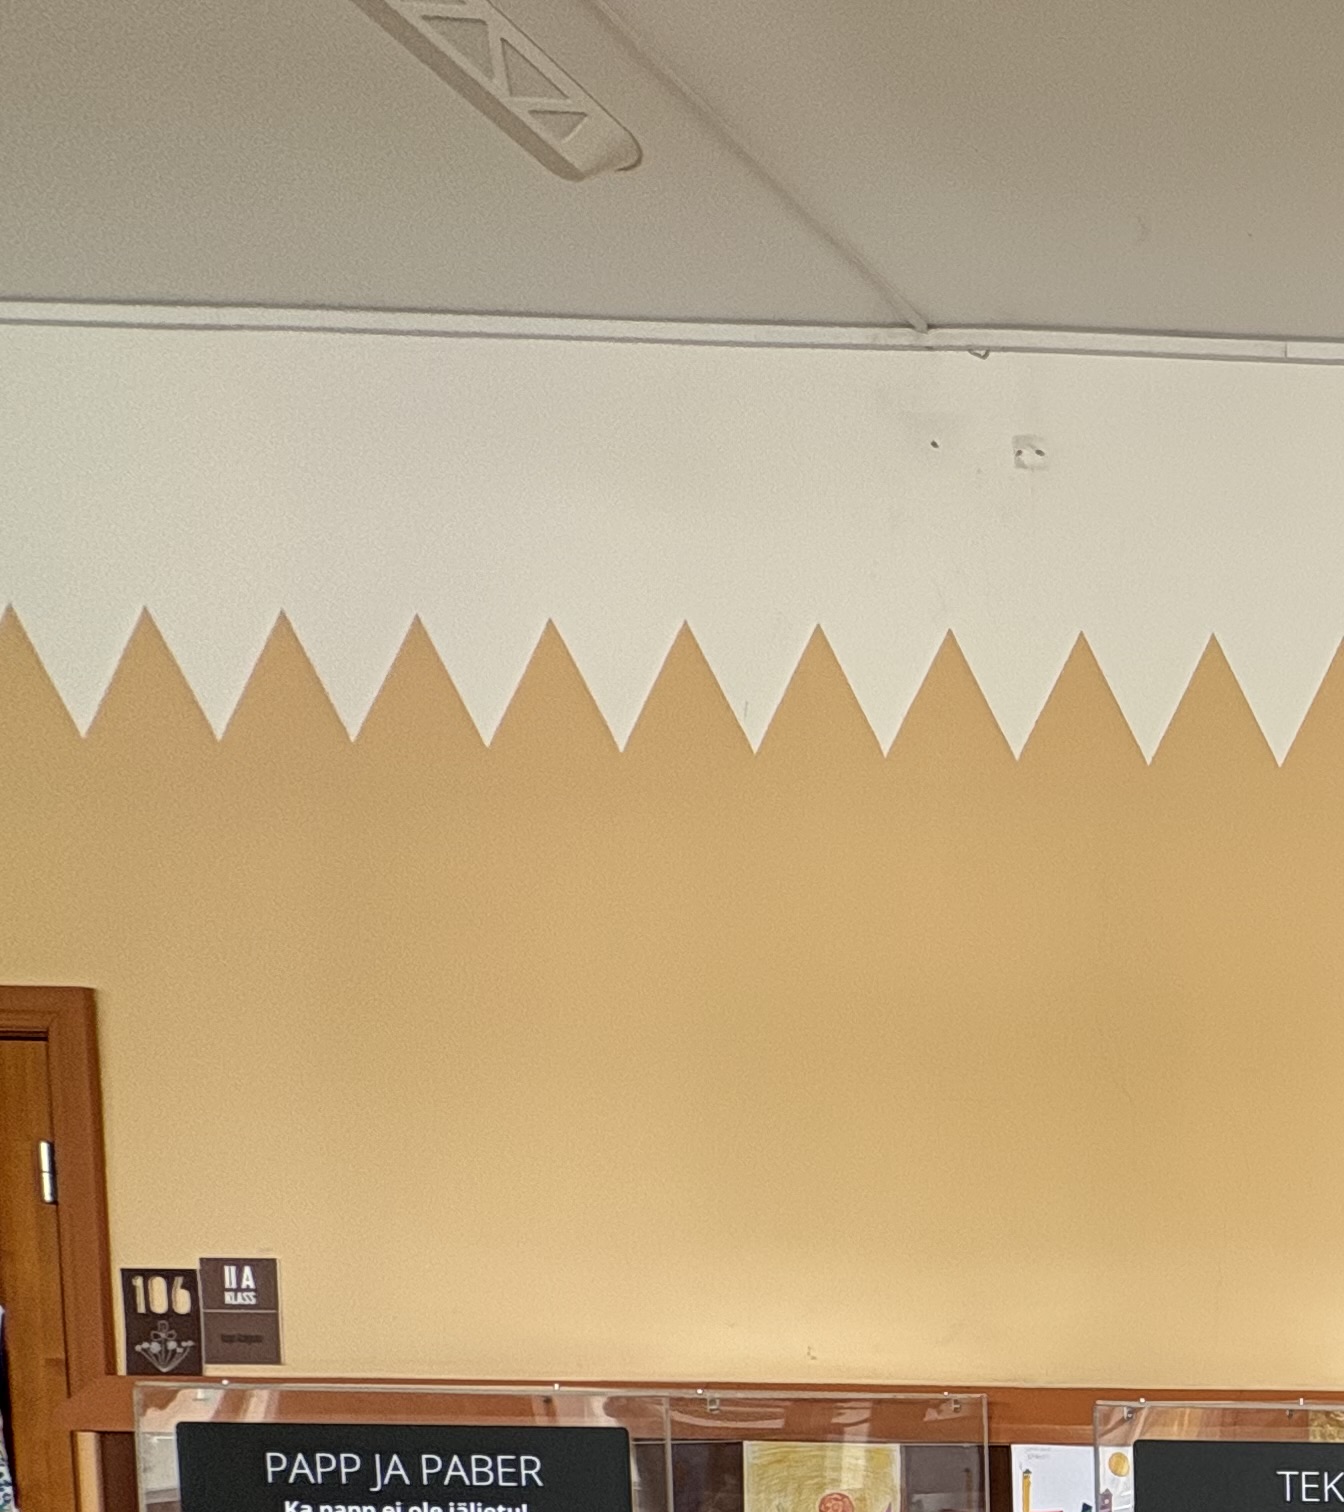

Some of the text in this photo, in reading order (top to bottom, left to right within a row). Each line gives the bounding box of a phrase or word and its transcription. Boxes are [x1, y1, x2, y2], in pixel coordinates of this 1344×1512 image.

[241, 1265, 255, 1288] A
[132, 1276, 191, 1314] 106
[225, 1292, 256, 1304] KLASS
[266, 1452, 543, 1491] PAPP JA PABER
